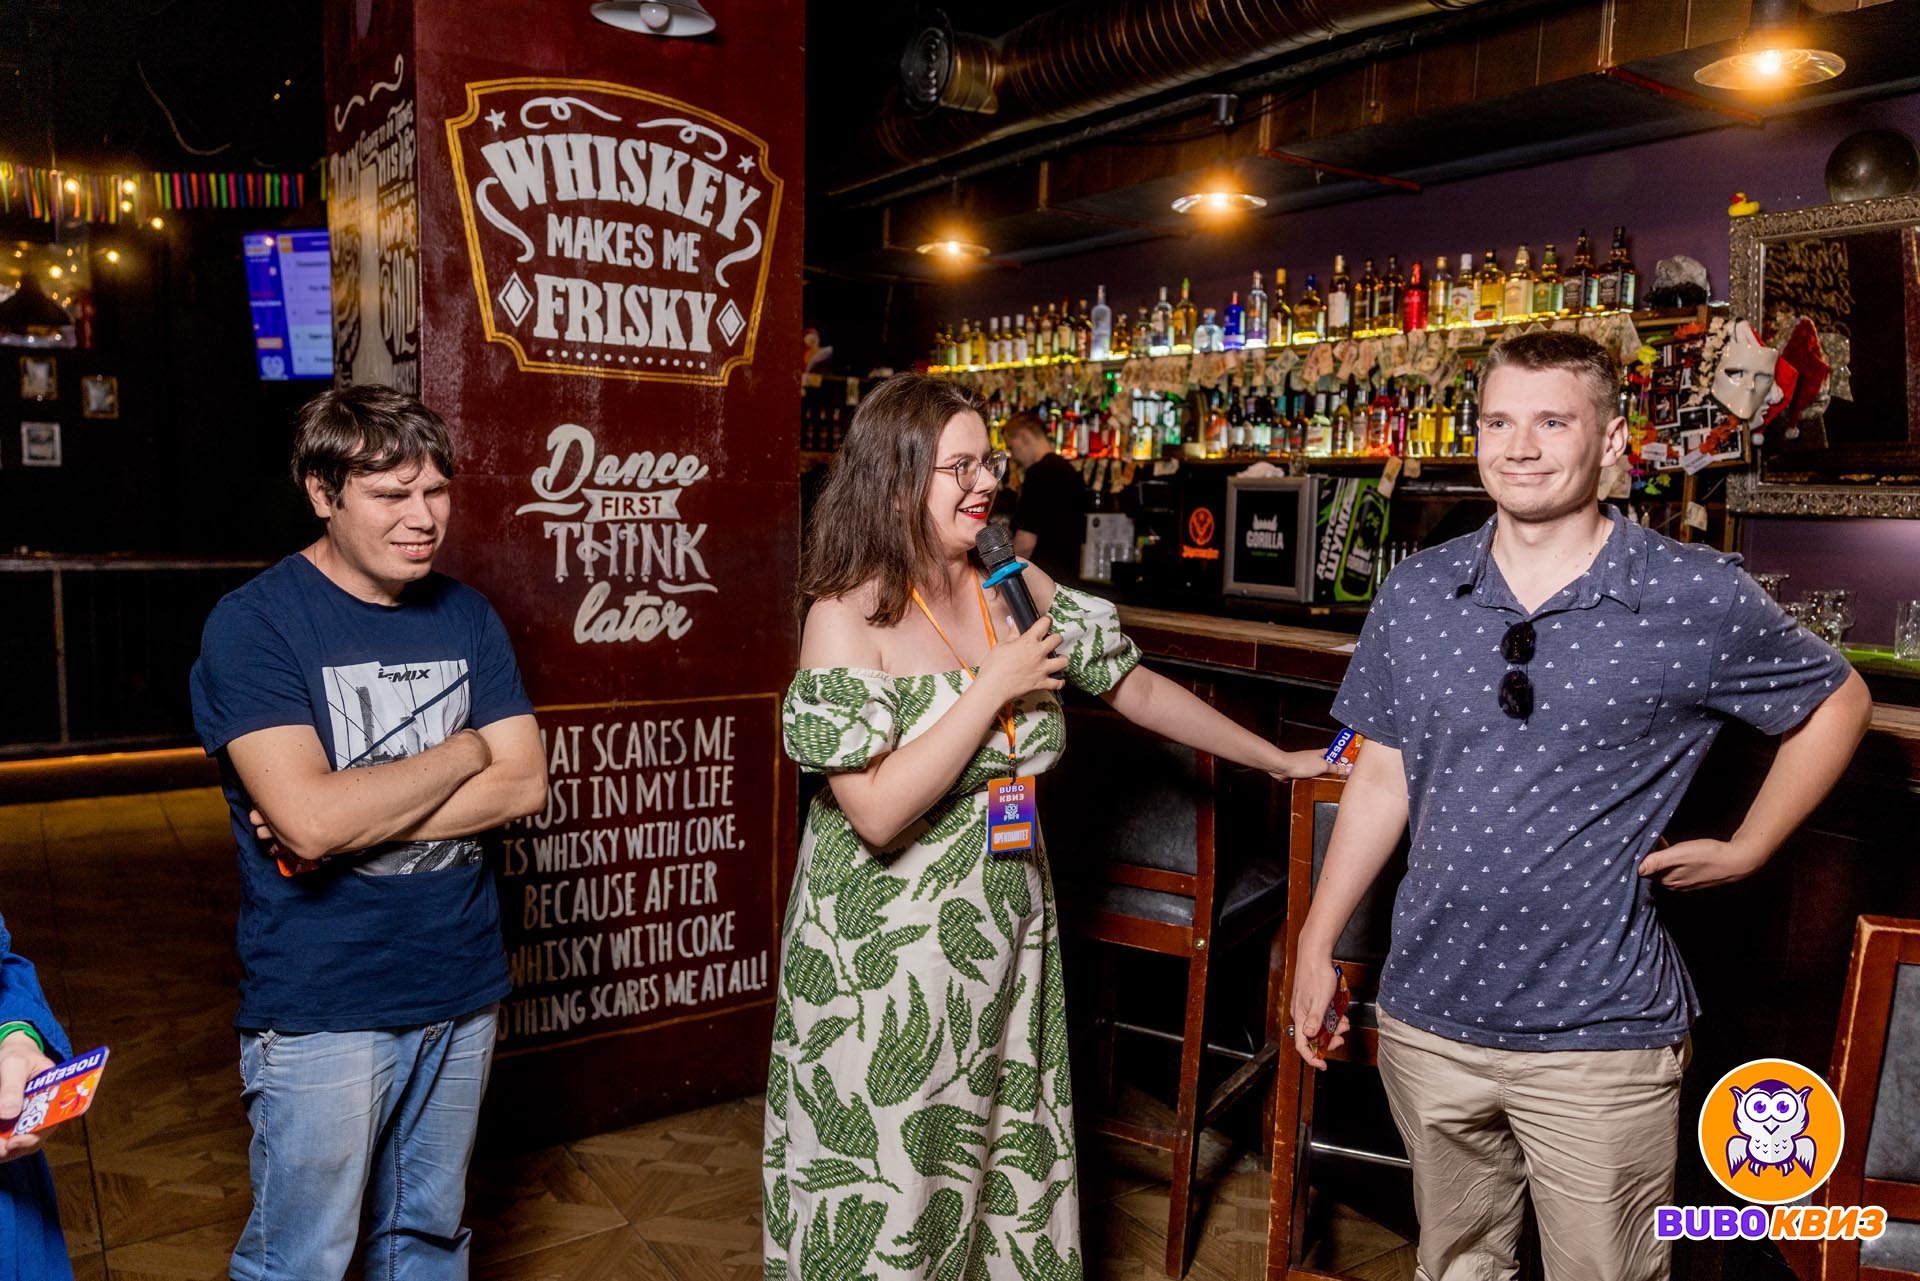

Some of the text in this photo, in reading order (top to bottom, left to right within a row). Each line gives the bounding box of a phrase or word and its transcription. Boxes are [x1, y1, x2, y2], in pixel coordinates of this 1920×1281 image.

[481, 133, 761, 241] WHISKEY
[547, 213, 701, 273] MAKES ME
[533, 273, 717, 353] FRISKY
[531, 423, 710, 501] Dance
[600, 496, 662, 517] FIRST
[543, 521, 711, 583] THINK
[1246, 530, 1284, 550] GORILLA
[574, 580, 693, 644] later
[540, 716, 735, 775] AT SCARES ME
[504, 765, 734, 830] OST IN MY LIFE
[999, 785, 1024, 794] BUBO
[999, 793, 1024, 803] КВИЗ
[502, 814, 746, 876] IS WHISKY WITH COKE,
[523, 860, 718, 930] BECAUSE AFTER
[505, 911, 735, 988] WHISKY WITH COKE
[590, 974, 658, 1020] SCARES
[665, 969, 698, 1006] ME
[700, 963, 726, 1001] AT
[727, 950, 768, 993] ALL!
